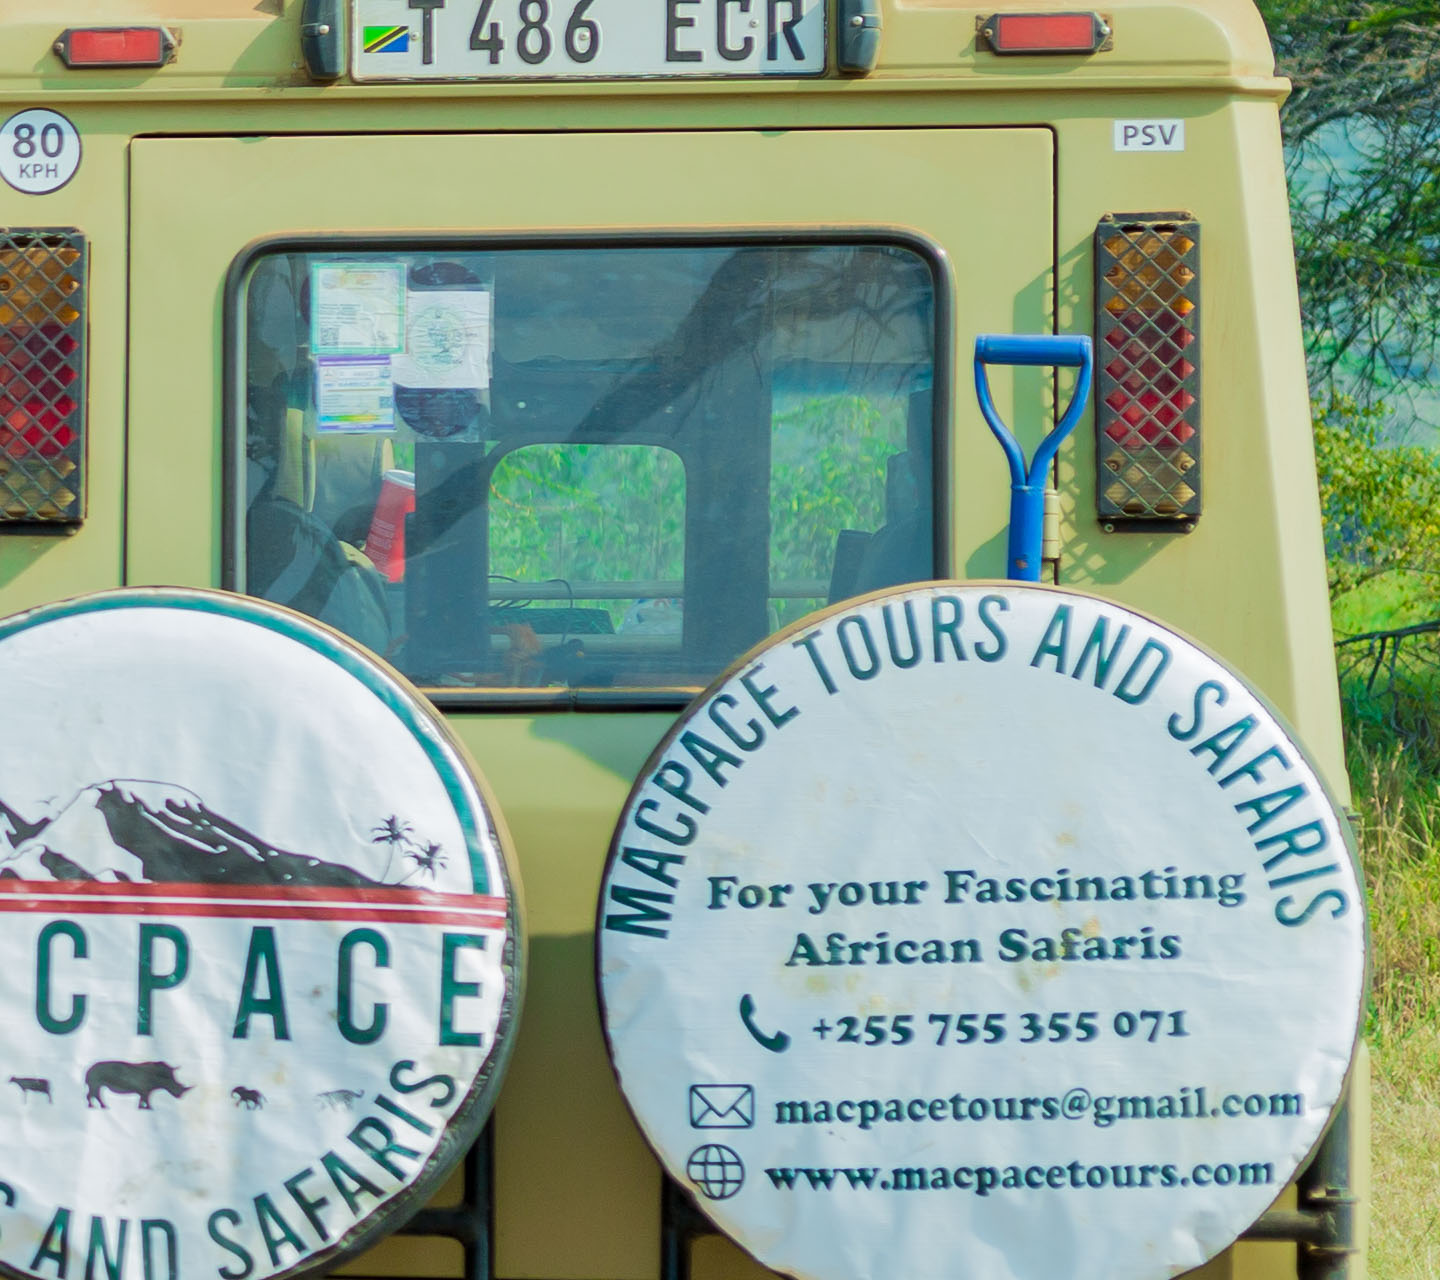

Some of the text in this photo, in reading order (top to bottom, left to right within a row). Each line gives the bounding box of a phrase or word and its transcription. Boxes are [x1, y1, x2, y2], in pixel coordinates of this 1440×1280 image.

[13, 122, 64, 158] 80
[1123, 124, 1177, 146] PSV
[19, 163, 58, 178] KPH
[606, 594, 1347, 940] MACPACE TOURS AND SAFARIS
[706, 866, 1247, 915] For your Fascinating
[784, 926, 1182, 967] African Safaris
[813, 1010, 1191, 1046] +255 755 355 071
[775, 1087, 1305, 1130] macpacetours@gmail.com
[764, 1160, 1275, 1197] www.macpacetours.com
